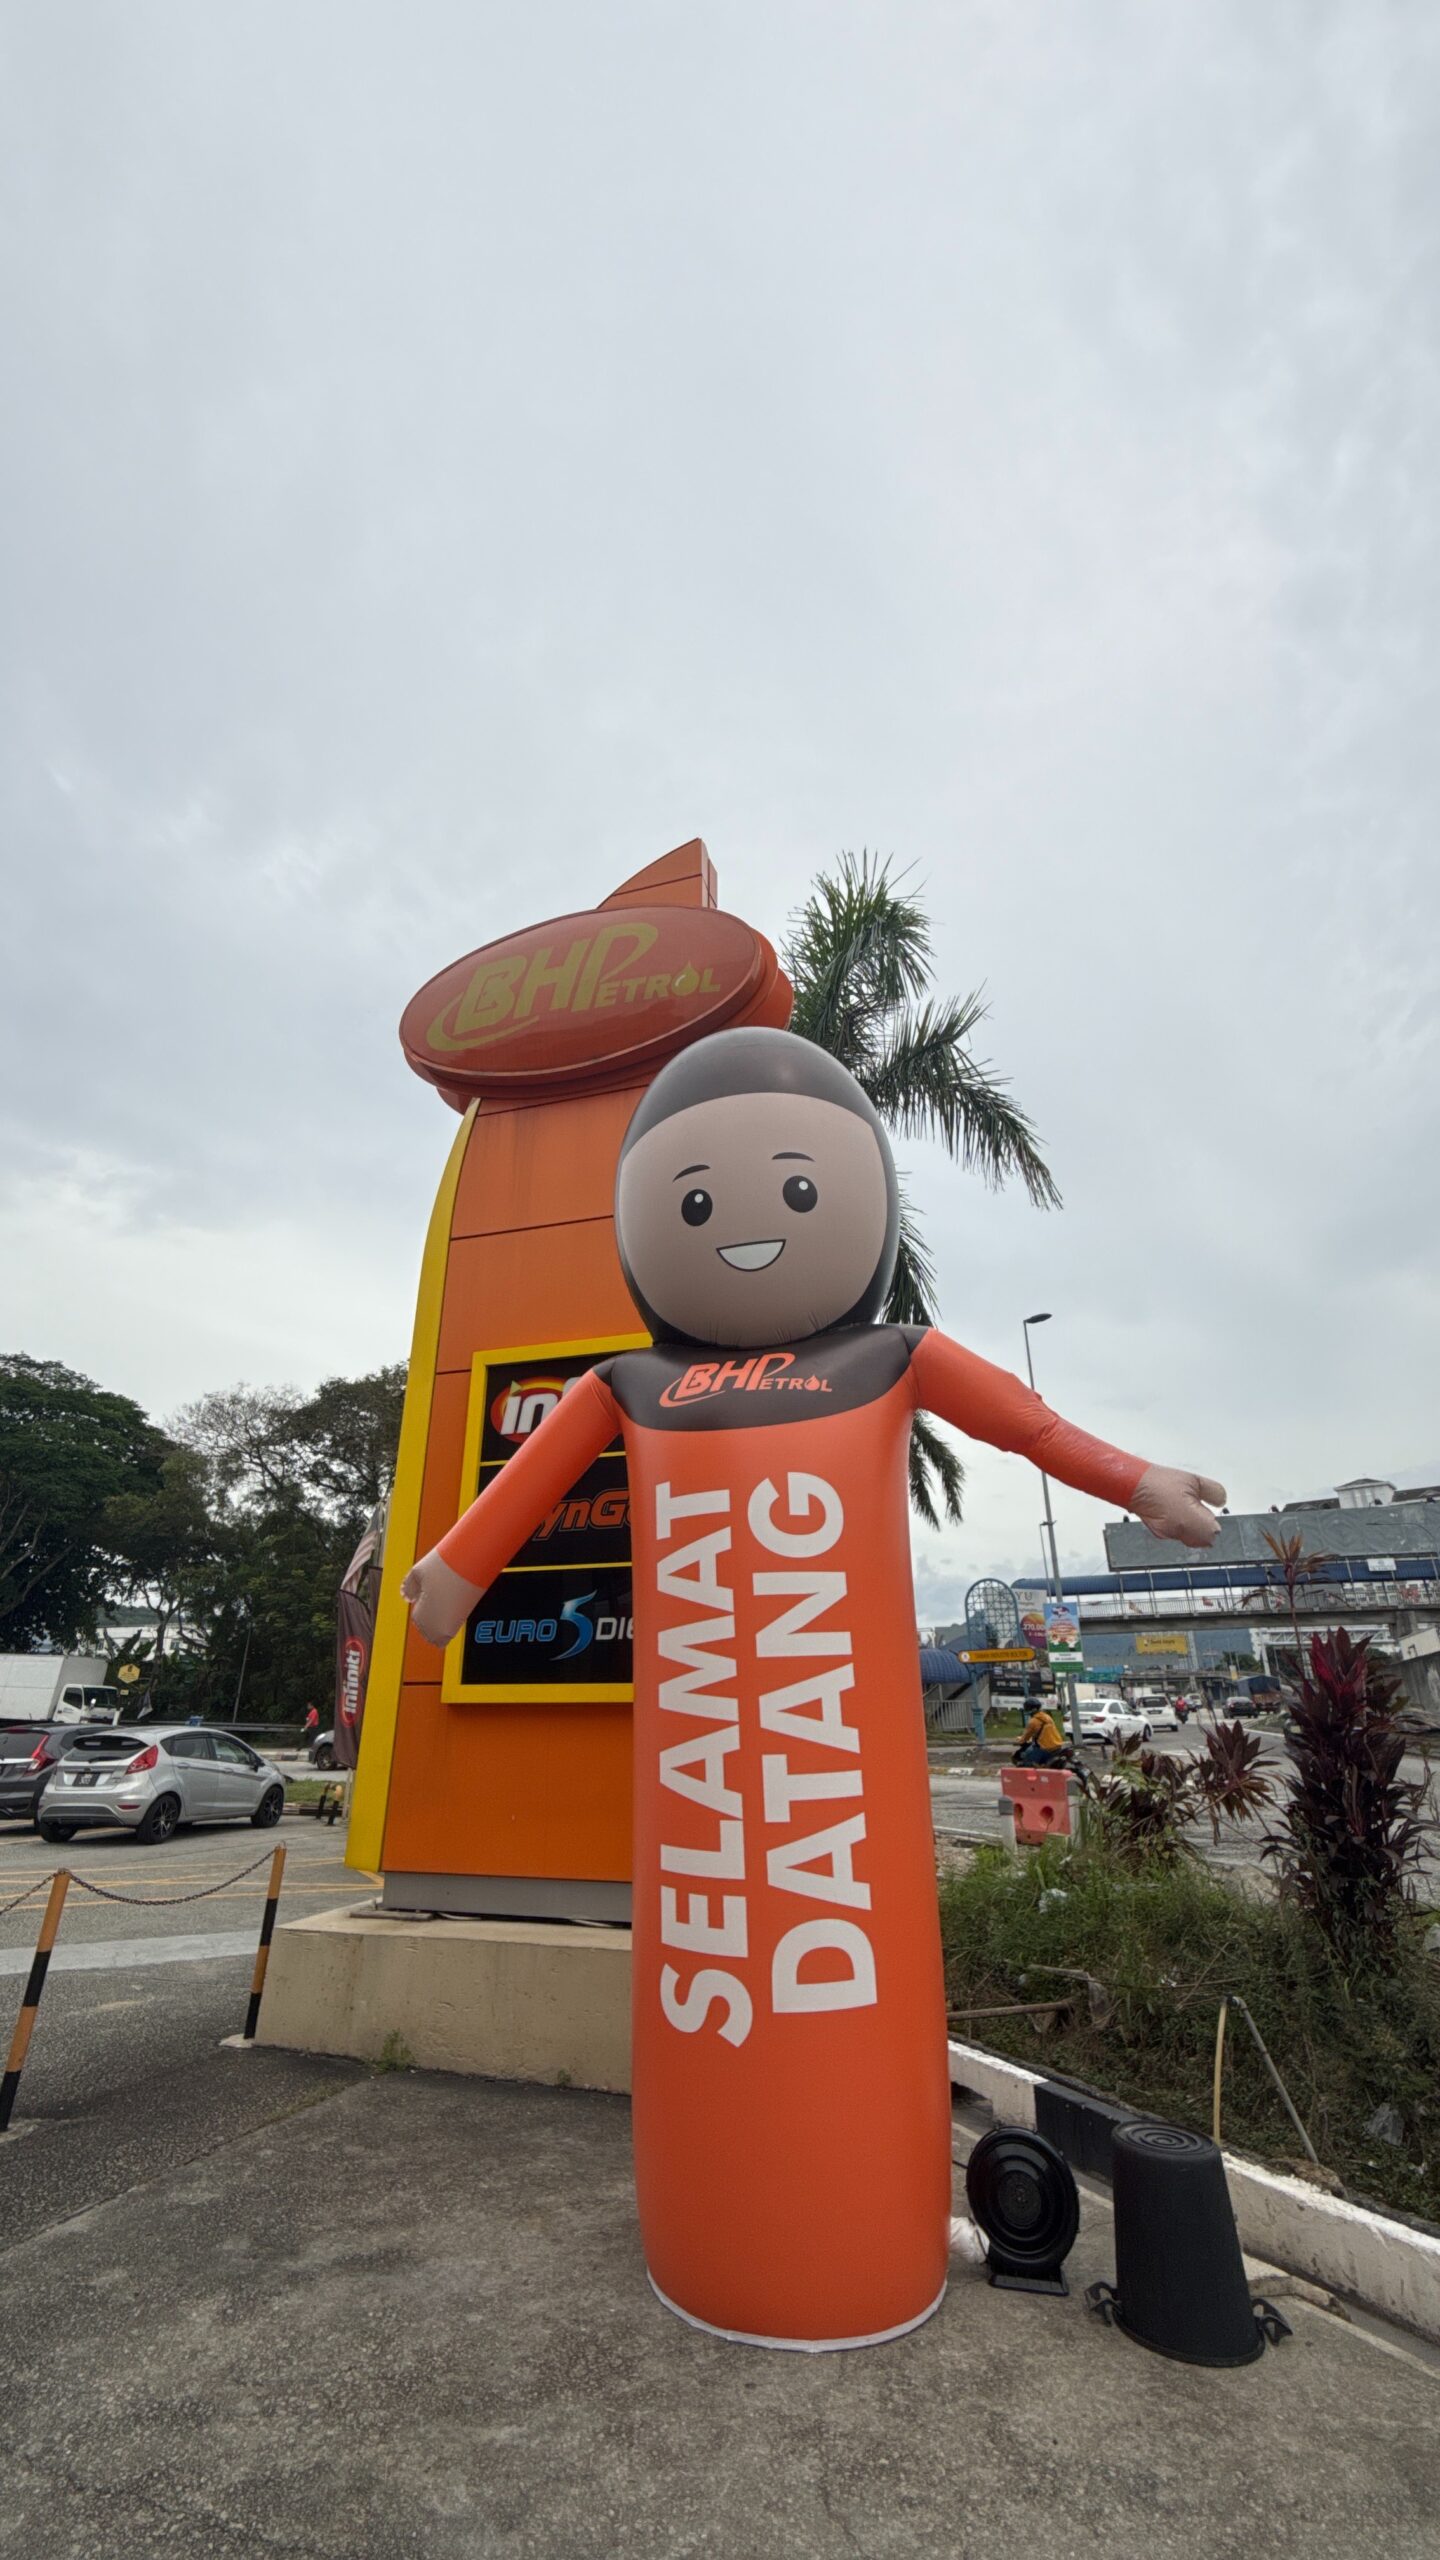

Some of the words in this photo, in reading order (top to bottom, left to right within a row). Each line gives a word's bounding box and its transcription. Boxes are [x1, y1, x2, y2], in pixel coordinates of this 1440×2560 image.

[501, 1377, 581, 1435] in
[474, 1618, 557, 1644] EURO
[342, 1648, 361, 1713] infiniti
[655, 1480, 754, 2047] SELAMAT
[747, 1471, 878, 2014] DATANG
